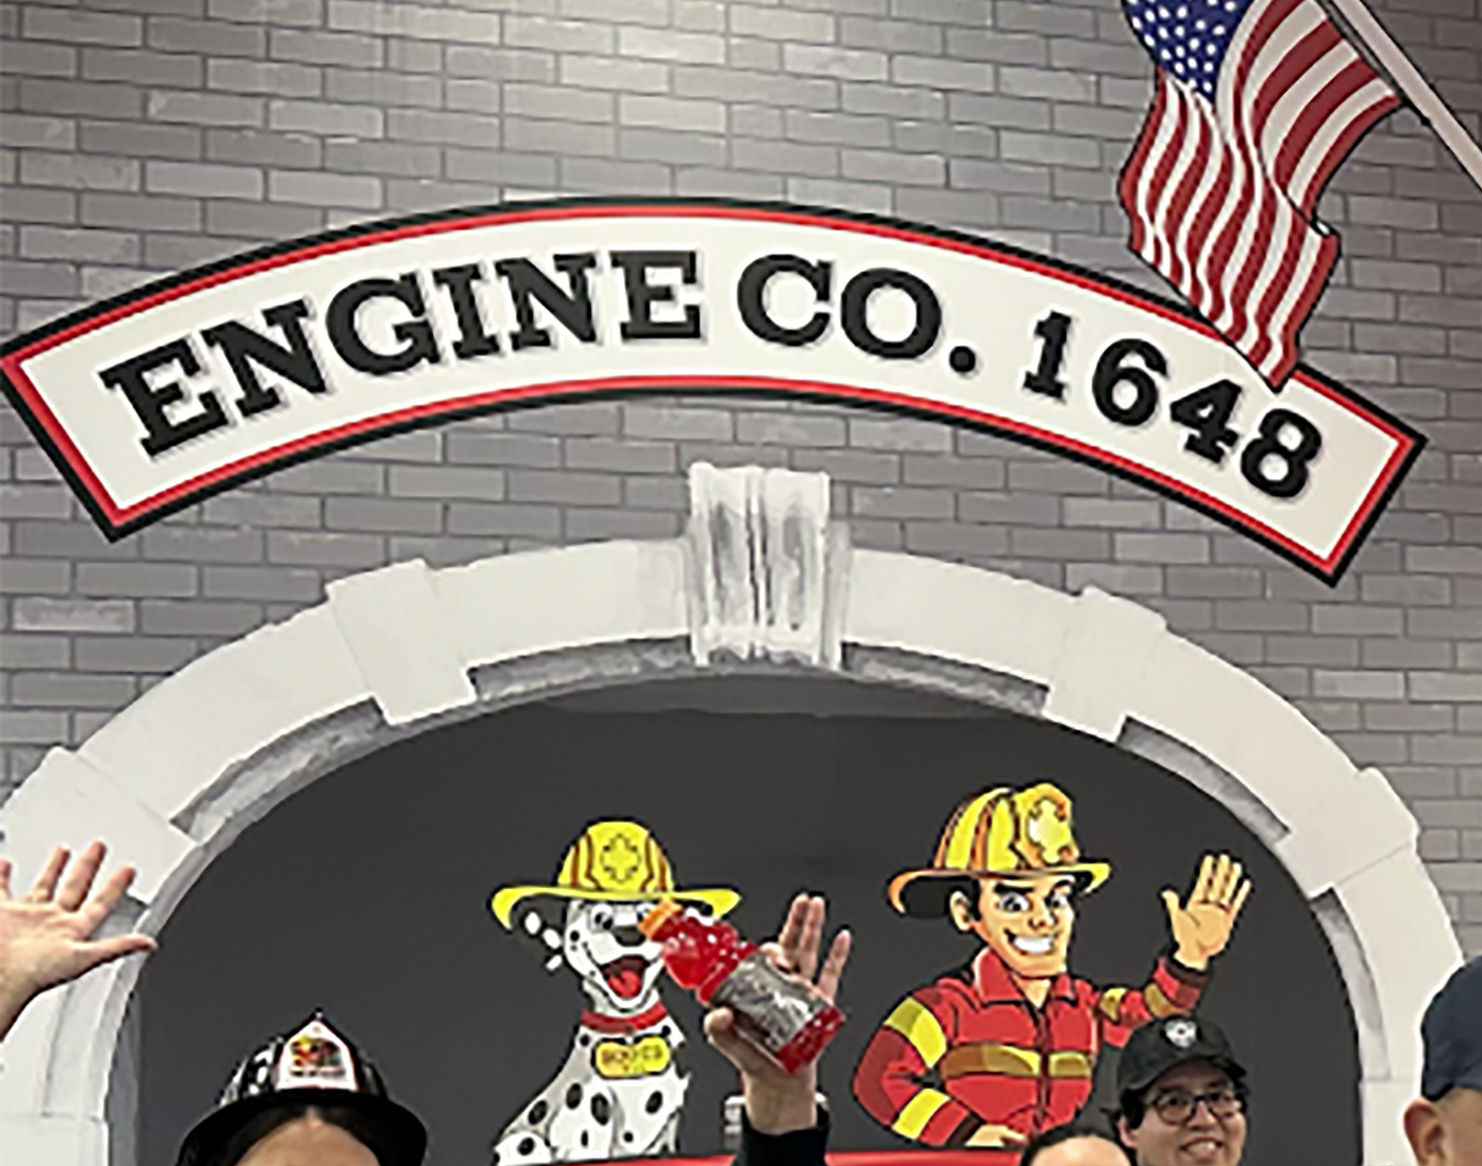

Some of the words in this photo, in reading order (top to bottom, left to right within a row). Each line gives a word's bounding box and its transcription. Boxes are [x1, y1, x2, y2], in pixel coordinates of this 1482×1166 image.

[100, 250, 701, 457] ENGINE
[736, 253, 977, 374] CO.
[1023, 311, 1322, 498] 1648
